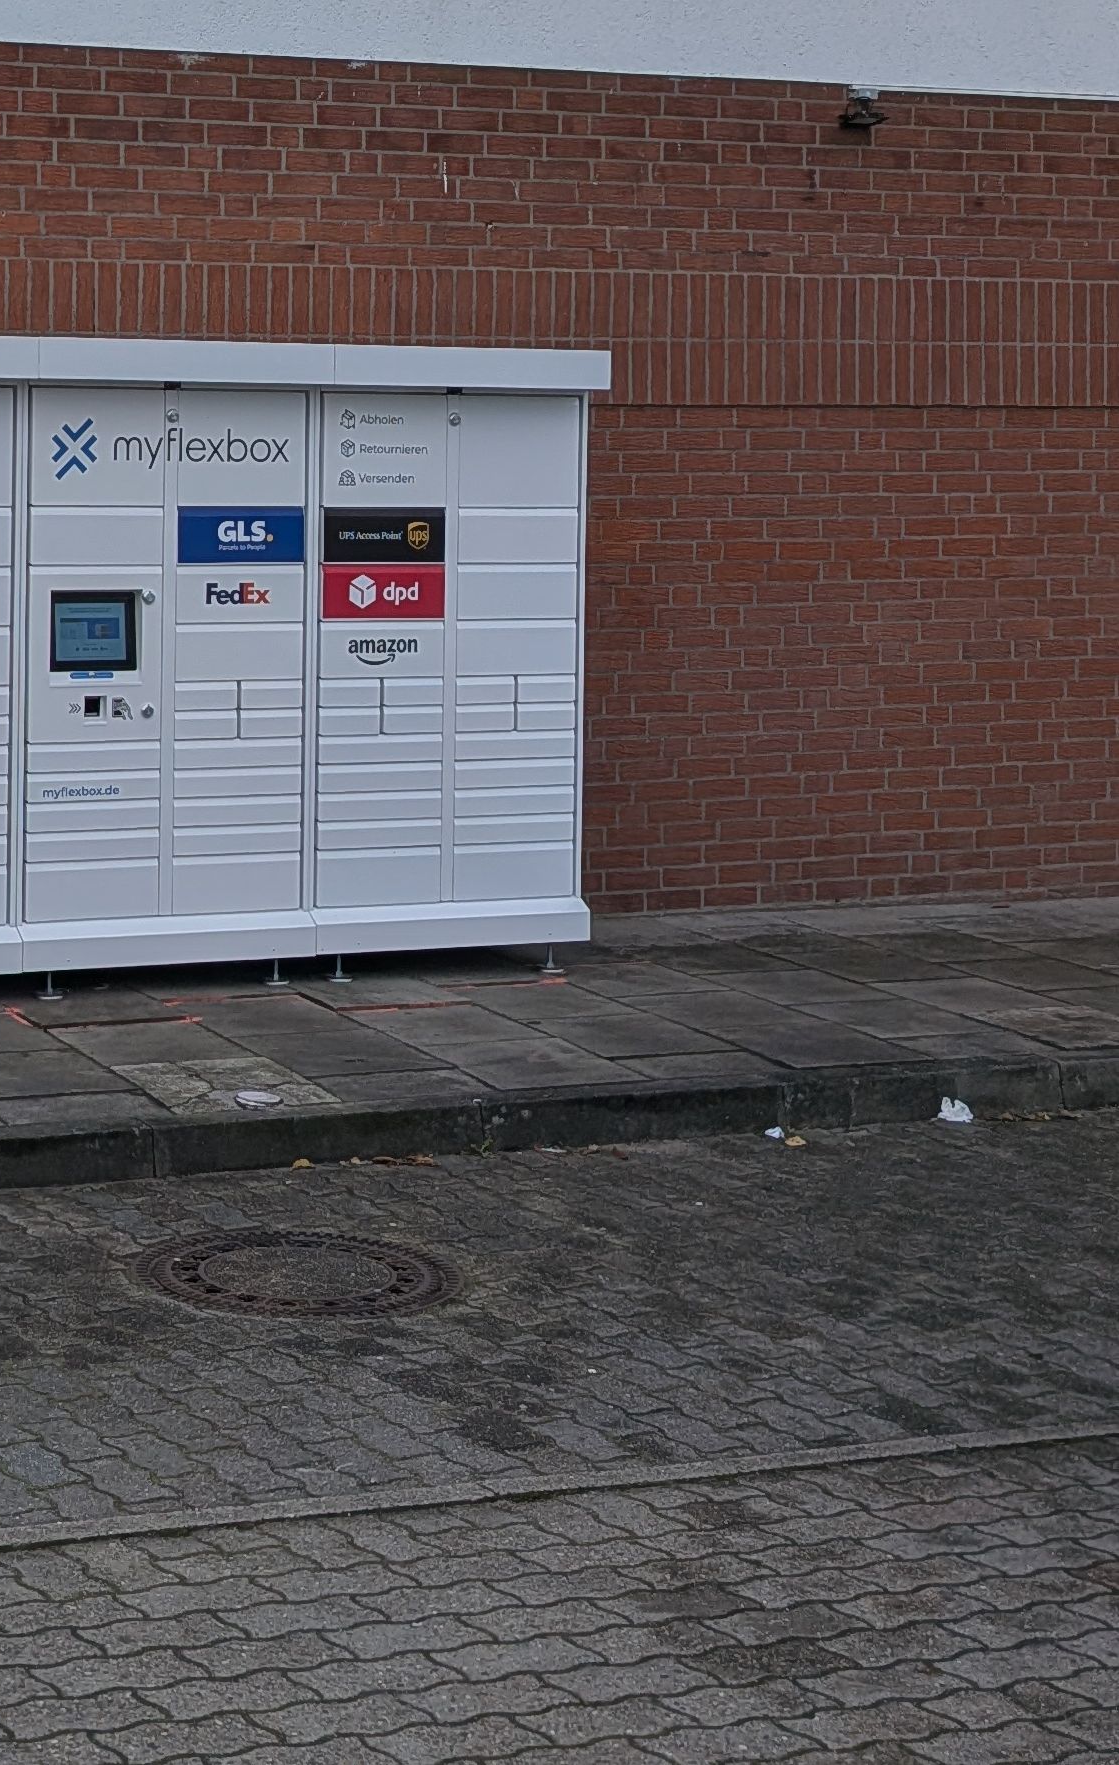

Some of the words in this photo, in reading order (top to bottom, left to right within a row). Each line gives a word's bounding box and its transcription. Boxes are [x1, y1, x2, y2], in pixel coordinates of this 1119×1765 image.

[359, 414, 404, 425] Abholen
[113, 427, 290, 470] myflexbox
[359, 443, 428, 455] Retournieren
[358, 473, 415, 484] Versenden
[338, 531, 355, 540] UPS
[355, 531, 381, 540] Access
[409, 530, 429, 546] ups
[205, 582, 270, 605] FedEx
[382, 581, 419, 606] dpd
[348, 637, 418, 654] amazon
[42, 785, 120, 800] myflexbox.de
